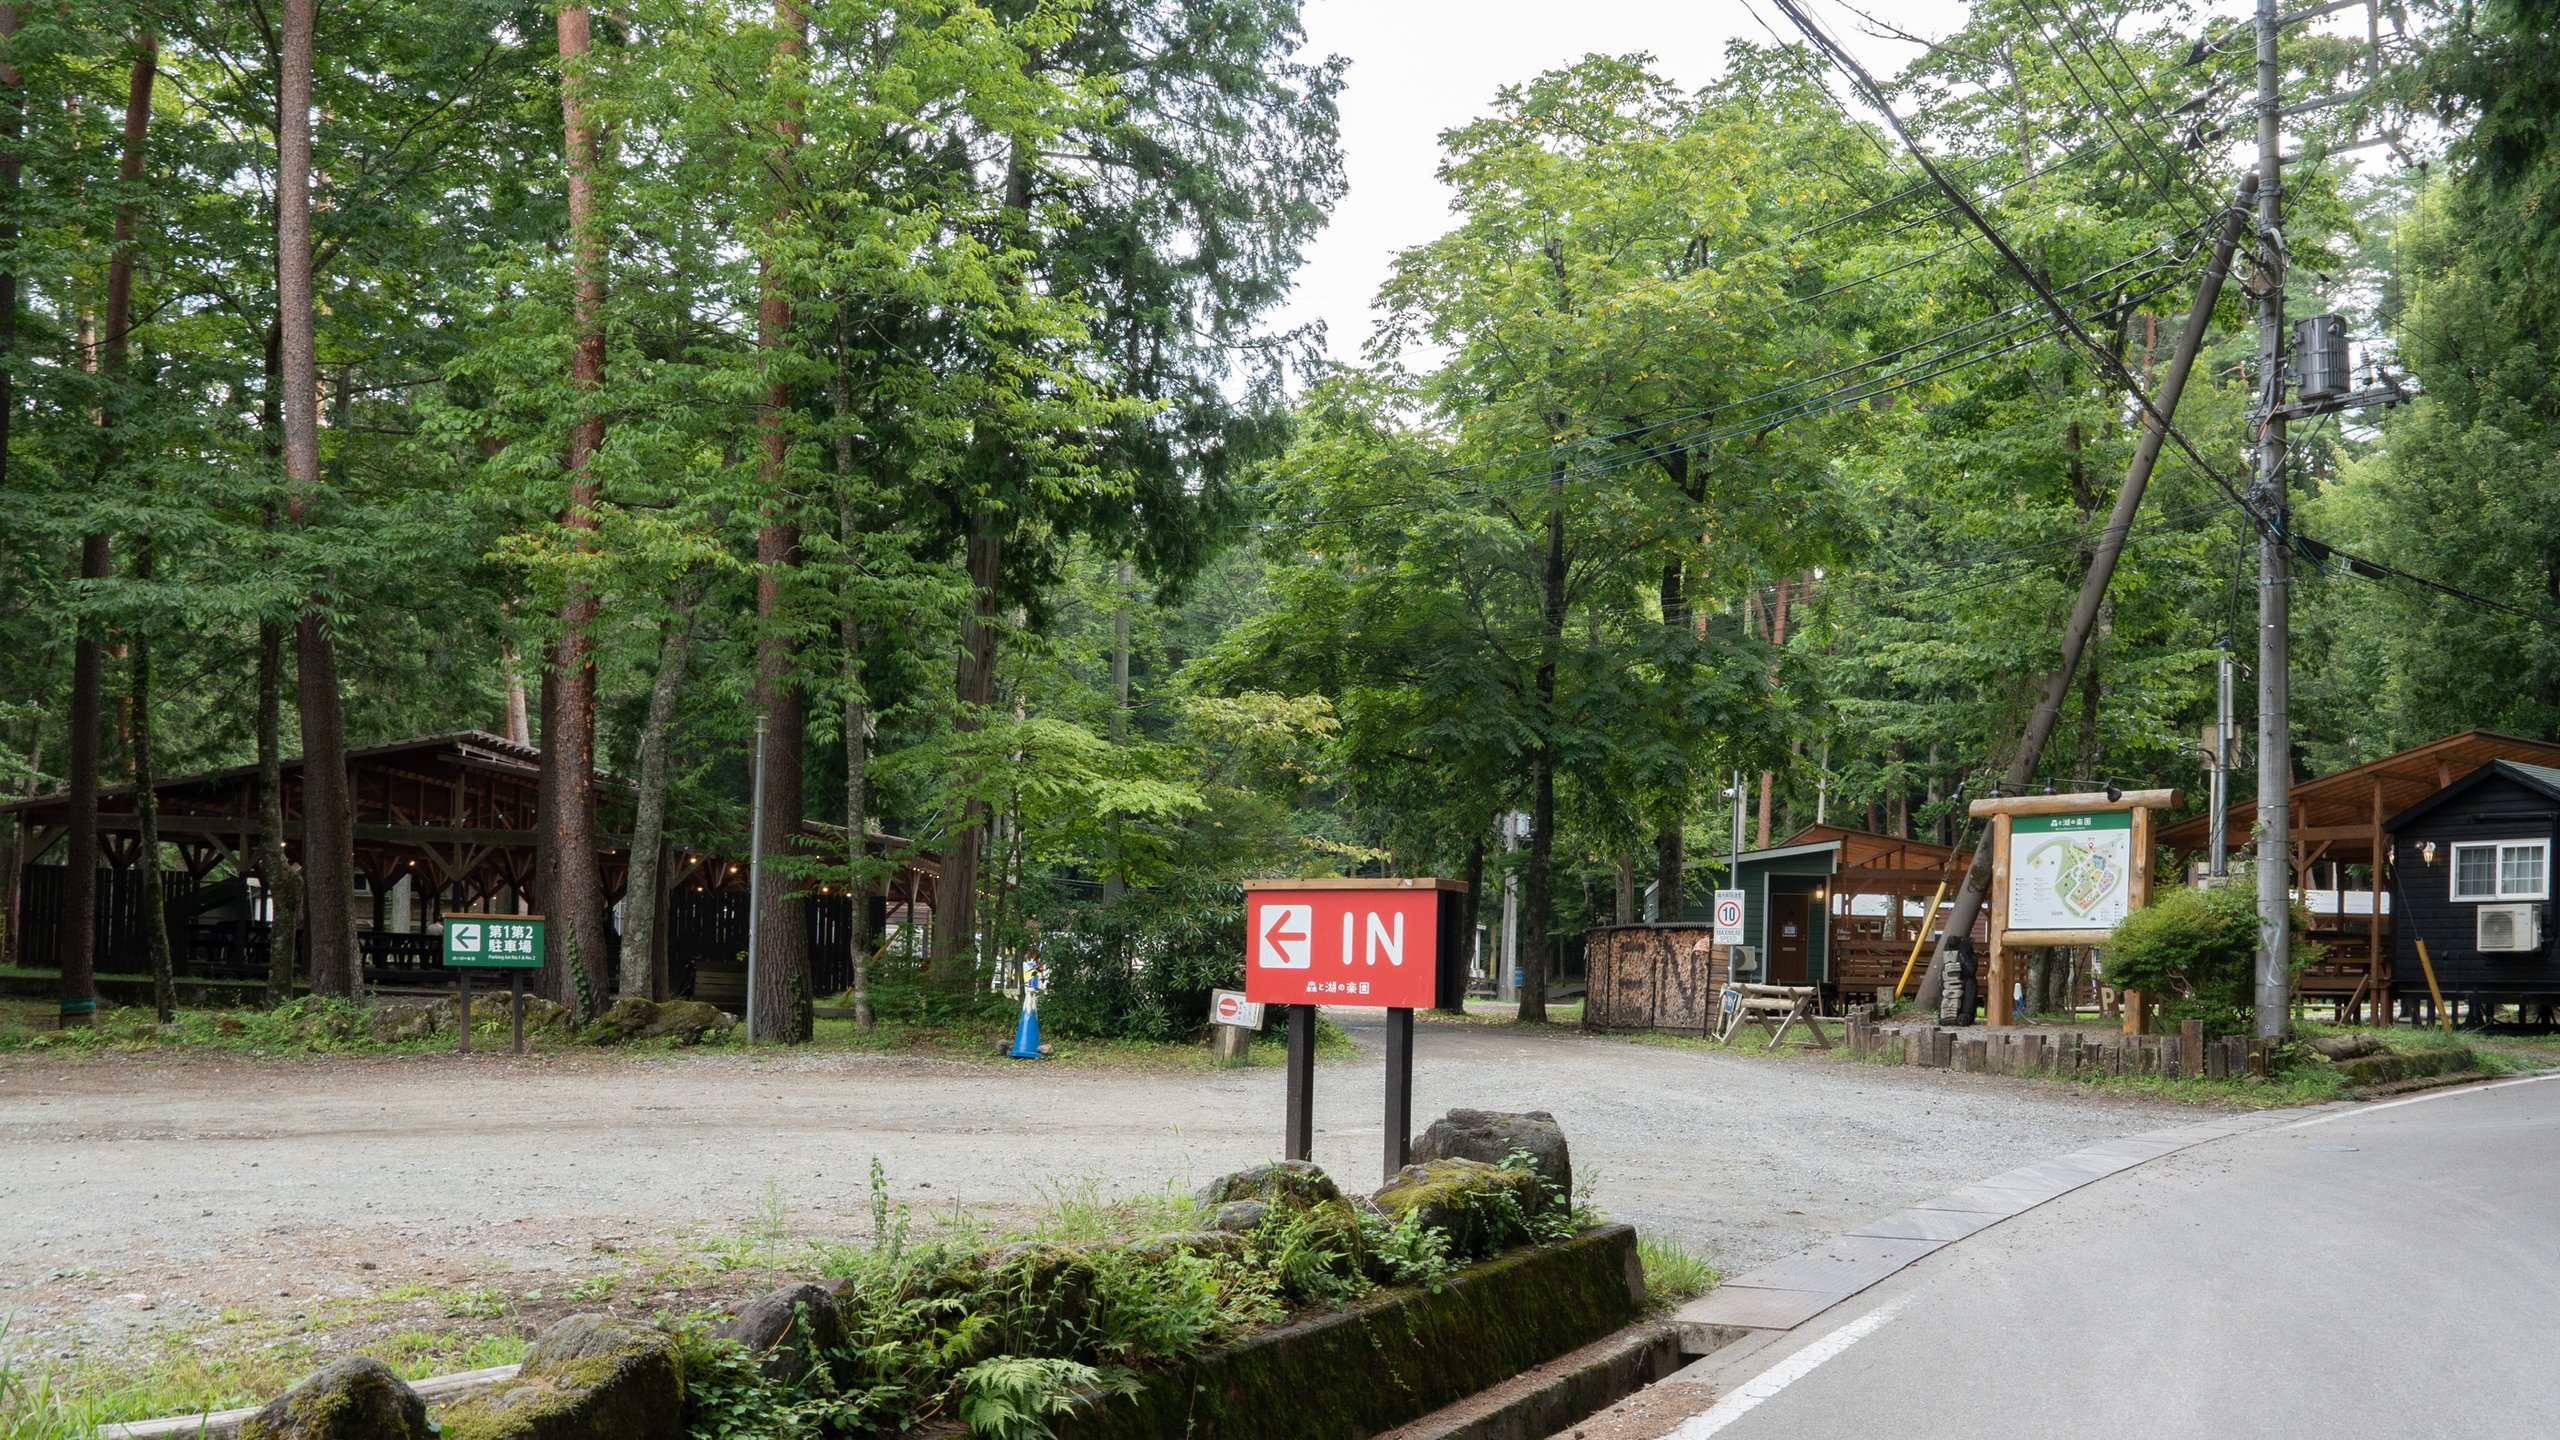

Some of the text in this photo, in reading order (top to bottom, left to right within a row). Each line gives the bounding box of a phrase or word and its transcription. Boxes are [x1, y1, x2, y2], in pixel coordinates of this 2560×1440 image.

[1722, 907, 1735, 921] 10
[489, 925, 533, 939] 第1第2
[1342, 911, 1404, 966] IN
[488, 939, 533, 953] 駐車場
[1306, 981, 1370, 994] 森と湖の楽園
[1940, 950, 1964, 1019] WELCOME
[2101, 987, 2115, 1011] P
